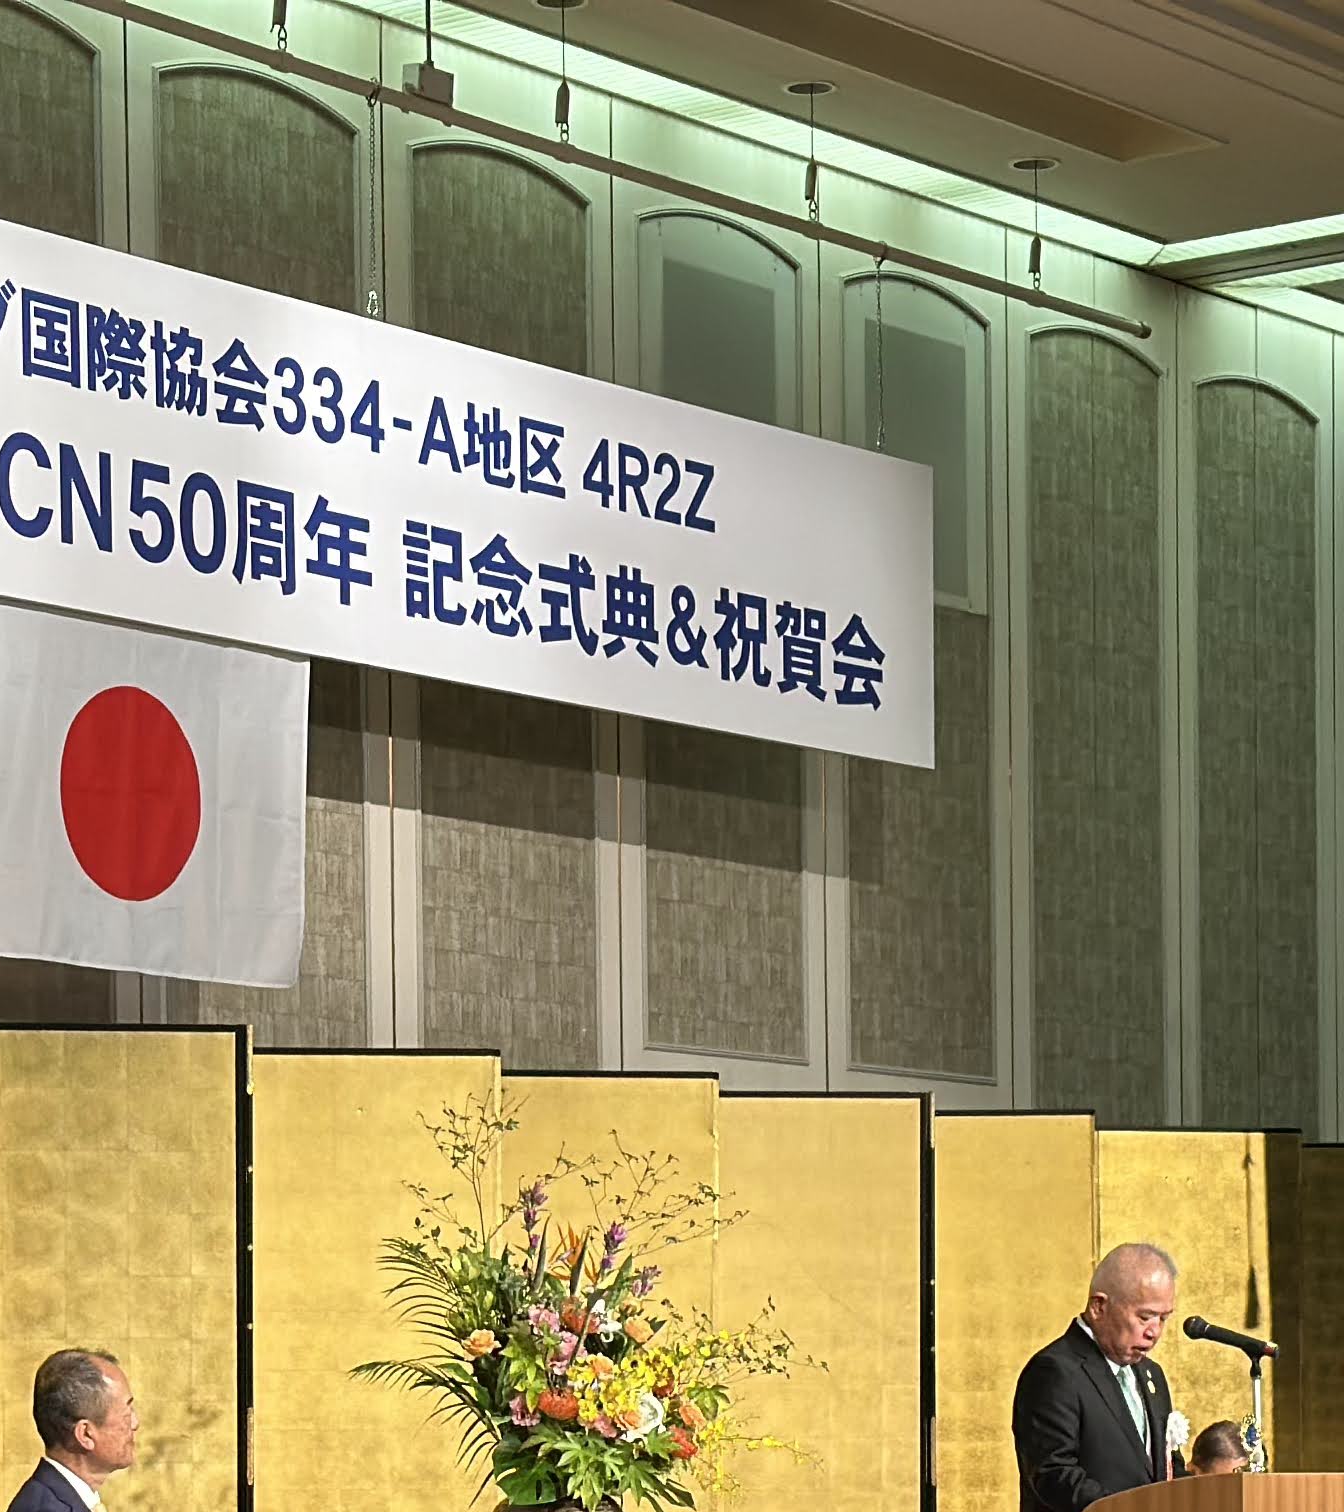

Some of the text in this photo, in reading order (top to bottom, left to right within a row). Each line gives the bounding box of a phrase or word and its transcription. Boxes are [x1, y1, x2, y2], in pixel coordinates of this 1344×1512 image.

[583, 438, 716, 533] 4R2Z
[402, 520, 886, 711] 記念式典&祝賀会
